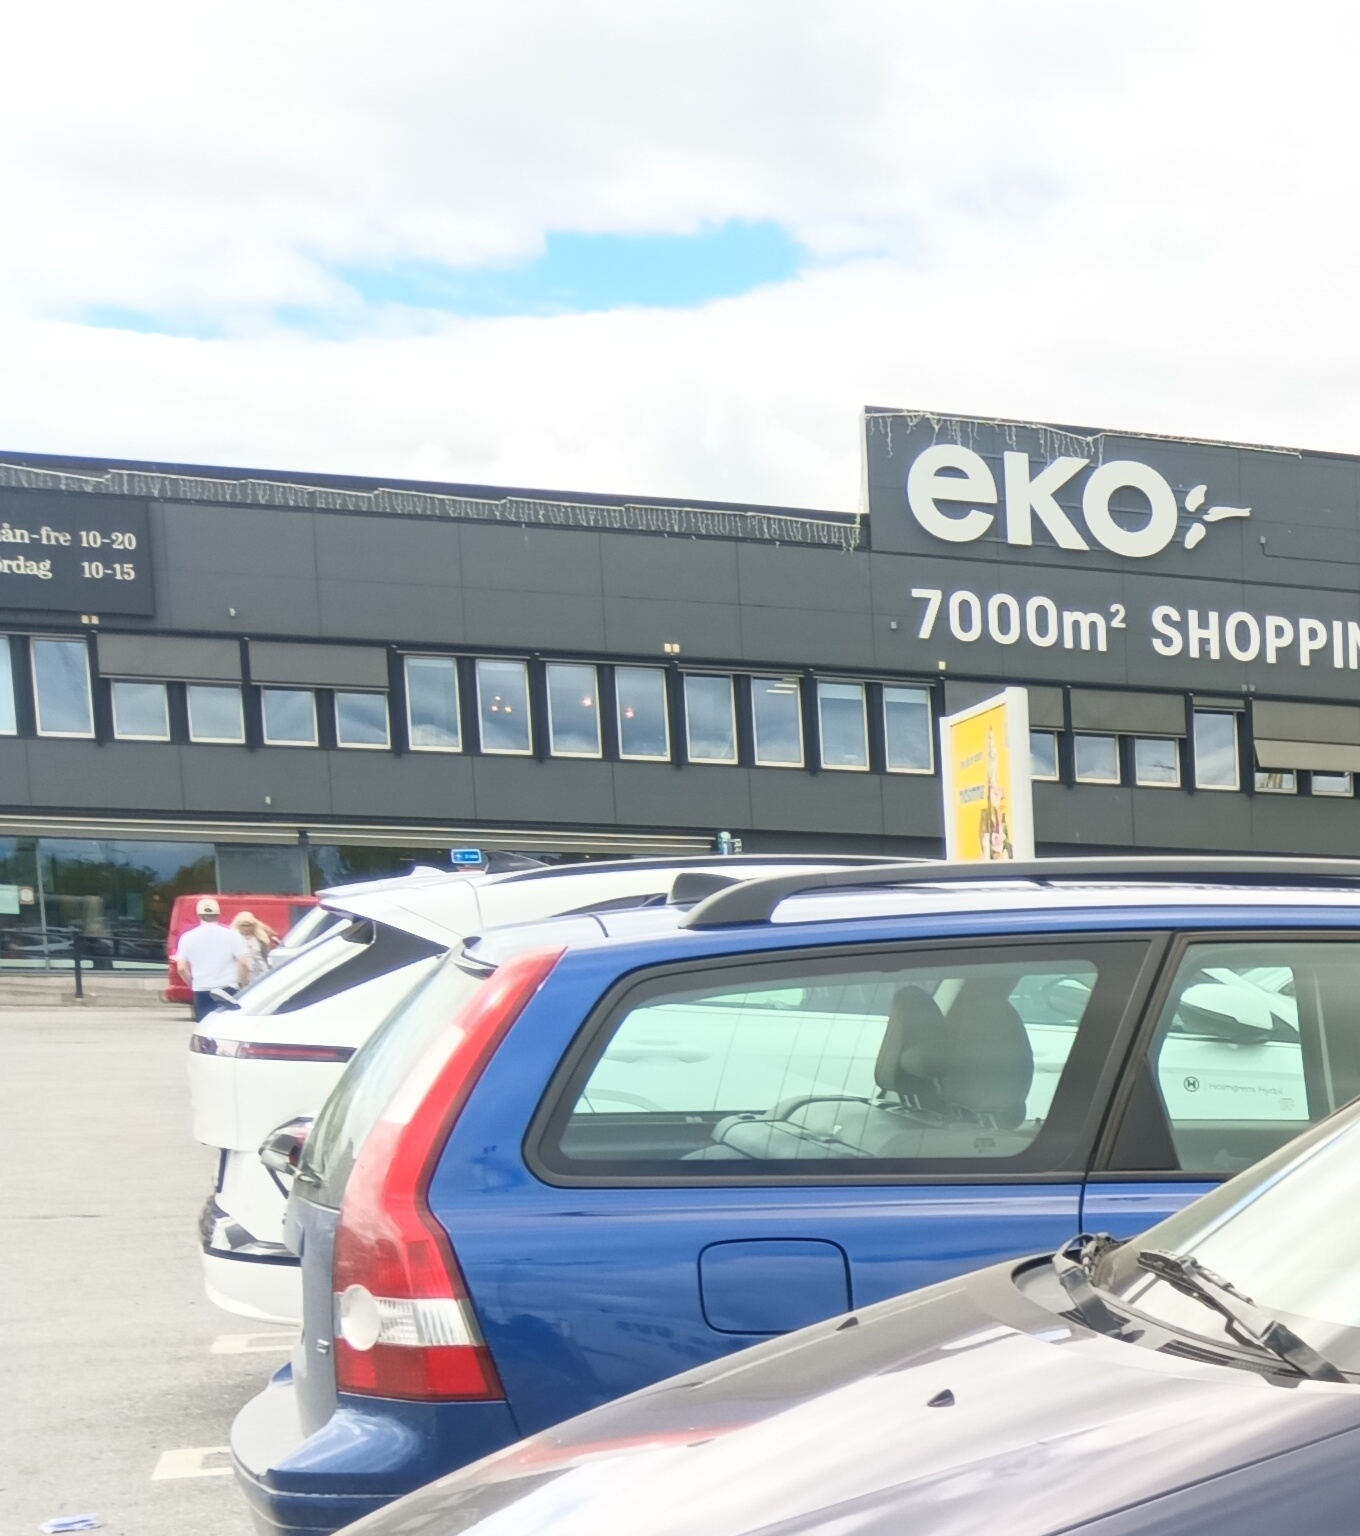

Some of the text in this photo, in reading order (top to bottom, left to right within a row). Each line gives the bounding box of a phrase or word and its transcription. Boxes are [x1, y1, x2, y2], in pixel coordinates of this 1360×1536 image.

[0, 523, 137, 550] ån-fre 10-20
[0, 555, 136, 580] rdag 10-15
